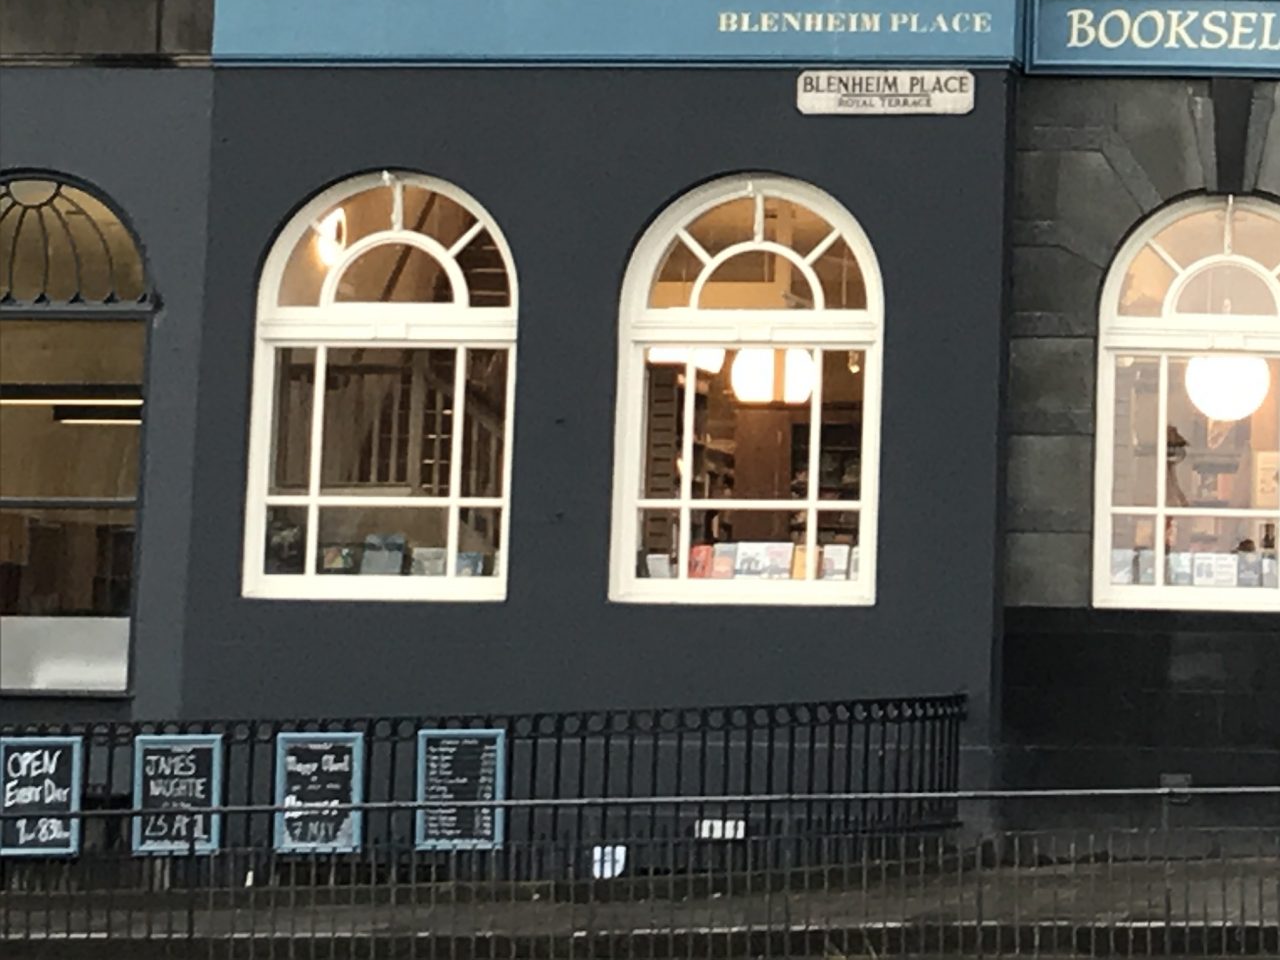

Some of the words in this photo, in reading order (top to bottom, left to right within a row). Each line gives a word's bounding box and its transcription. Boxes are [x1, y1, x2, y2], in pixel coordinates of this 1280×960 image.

[717, 11, 881, 33] BLENHEIM
[890, 11, 992, 33] PLACE
[803, 75, 899, 94] BLENHEIM
[909, 75, 970, 94] PLACE
[838, 97, 876, 108] ROYAL
[880, 96, 933, 108] TERRACE
[7, 749, 62, 778] OPEN
